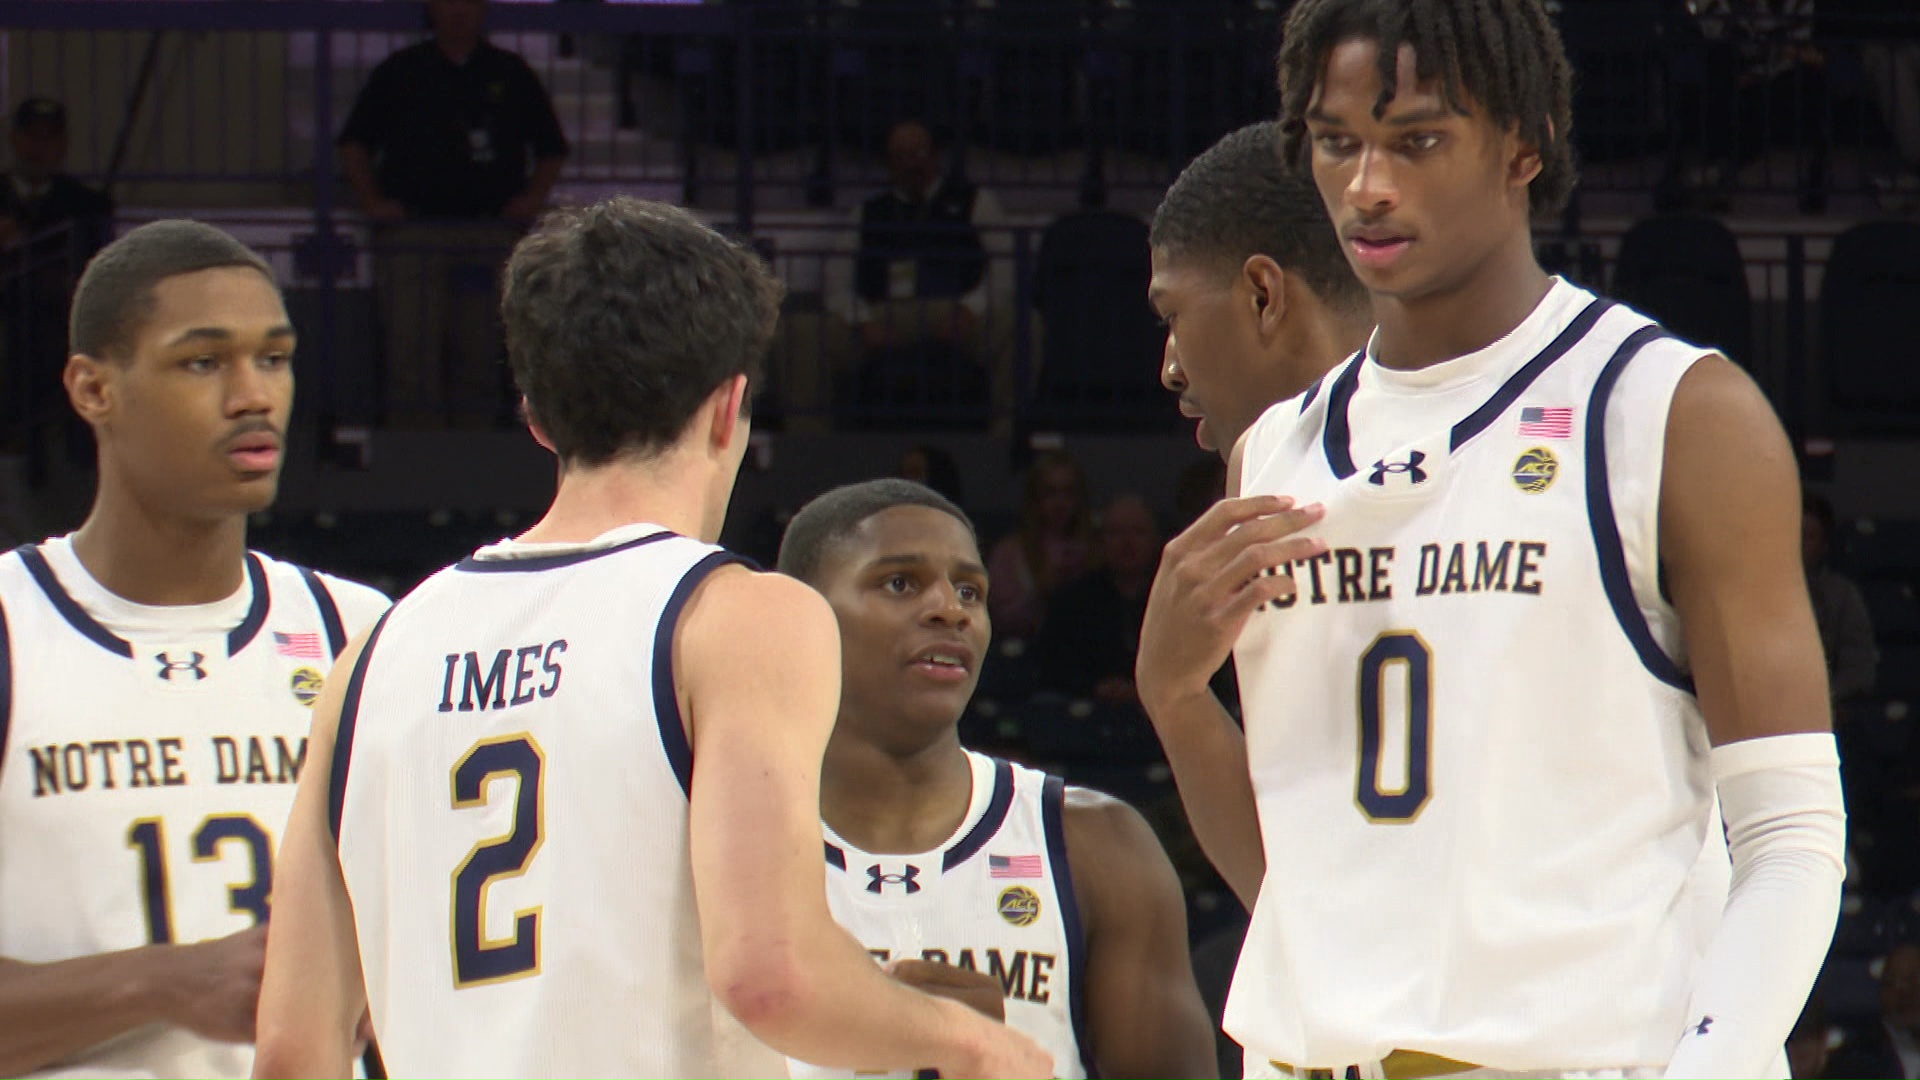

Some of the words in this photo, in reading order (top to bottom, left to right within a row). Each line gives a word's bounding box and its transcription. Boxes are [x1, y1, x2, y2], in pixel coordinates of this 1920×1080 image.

[1231, 546, 1396, 611] TRE
[1415, 540, 1548, 597] DAME
[438, 639, 568, 713] IMES
[1353, 628, 1435, 825] 0
[29, 735, 190, 798] NOTRE
[211, 734, 309, 785] DAM
[127, 812, 276, 944] 13
[449, 730, 546, 991] 2
[920, 948, 1056, 1005] ME
